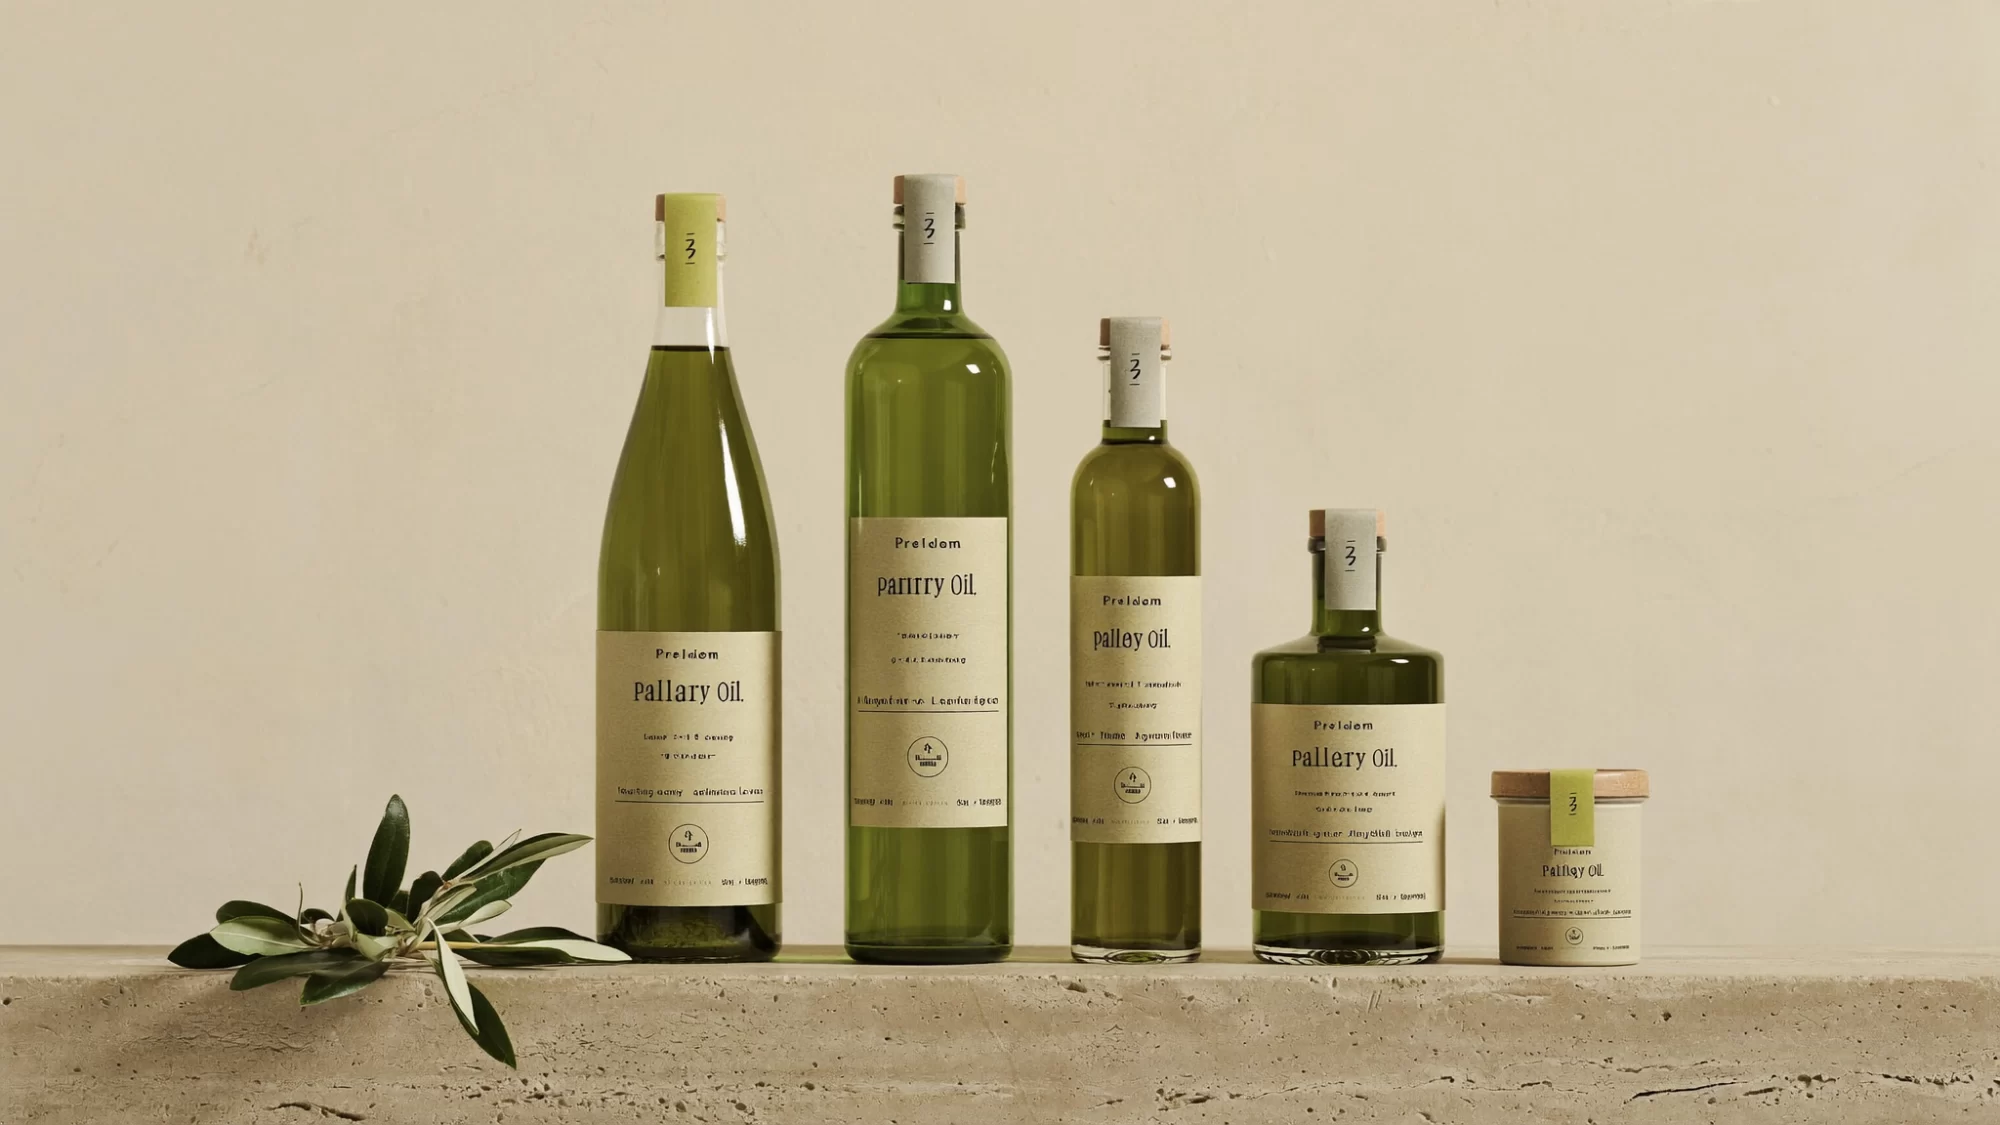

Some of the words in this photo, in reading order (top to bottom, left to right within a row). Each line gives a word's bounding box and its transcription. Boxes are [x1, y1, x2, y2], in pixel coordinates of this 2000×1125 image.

[895, 537, 961, 549] Preldom
[633, 679, 711, 705] Pallary
[717, 680, 744, 702] Oil.
[1292, 746, 1366, 770] Pallery
[1372, 748, 1398, 768] Oil.
